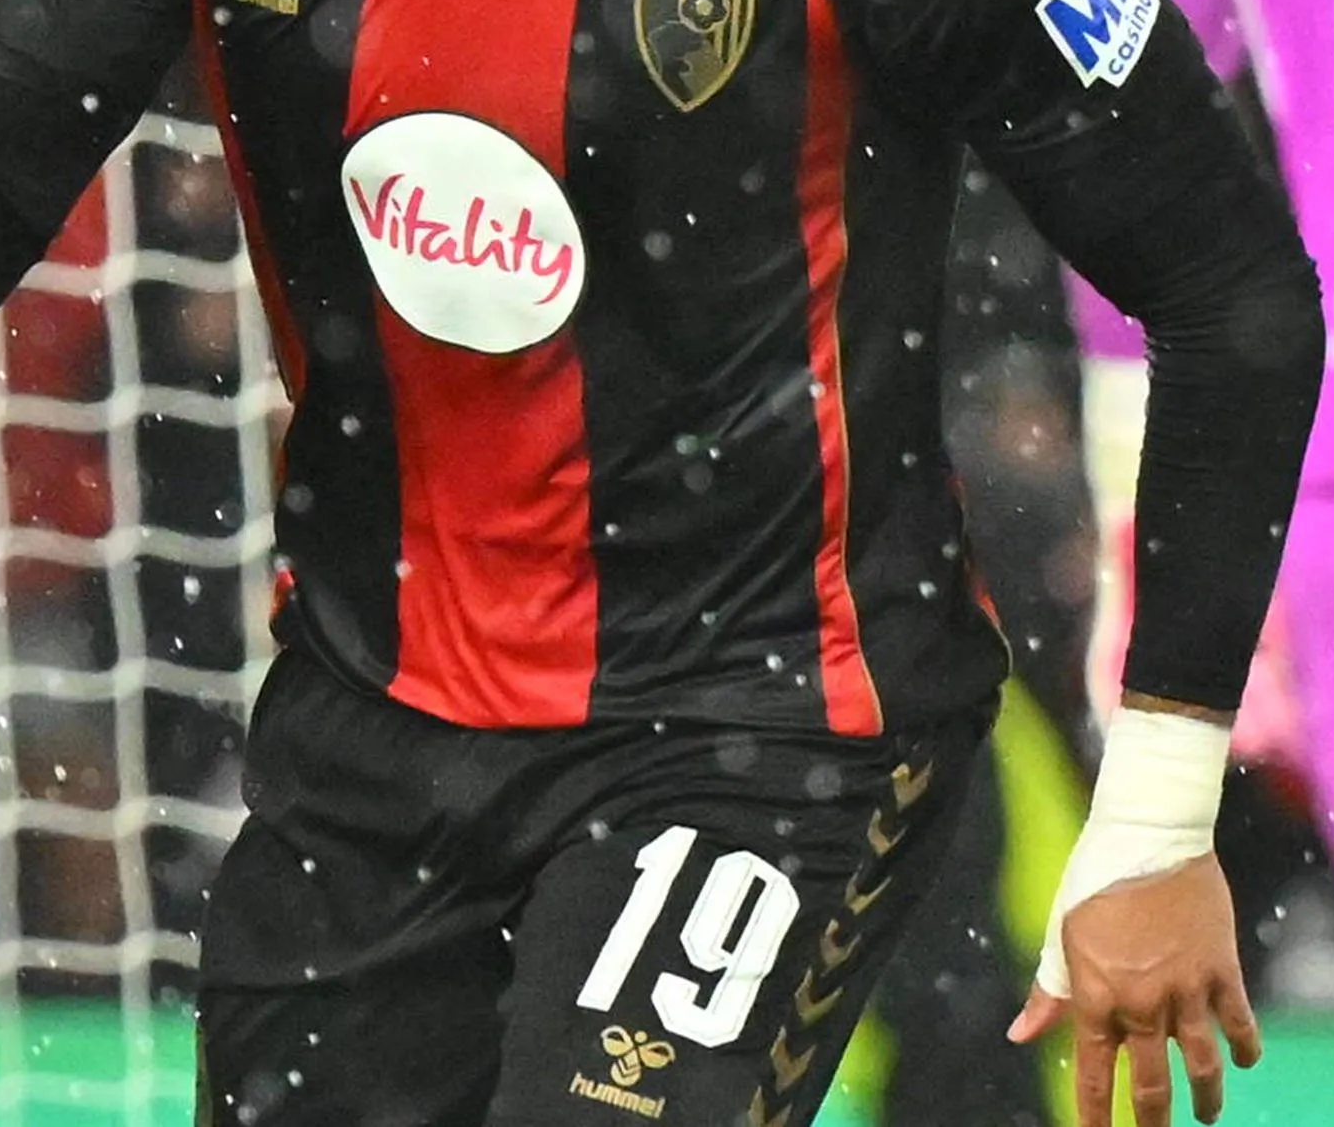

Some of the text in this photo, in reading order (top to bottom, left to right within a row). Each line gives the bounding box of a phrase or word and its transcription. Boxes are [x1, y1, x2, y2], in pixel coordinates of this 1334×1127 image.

[349, 173, 573, 306] Vitality
[575, 825, 801, 1049] 19
[569, 1071, 666, 1119] hummel
